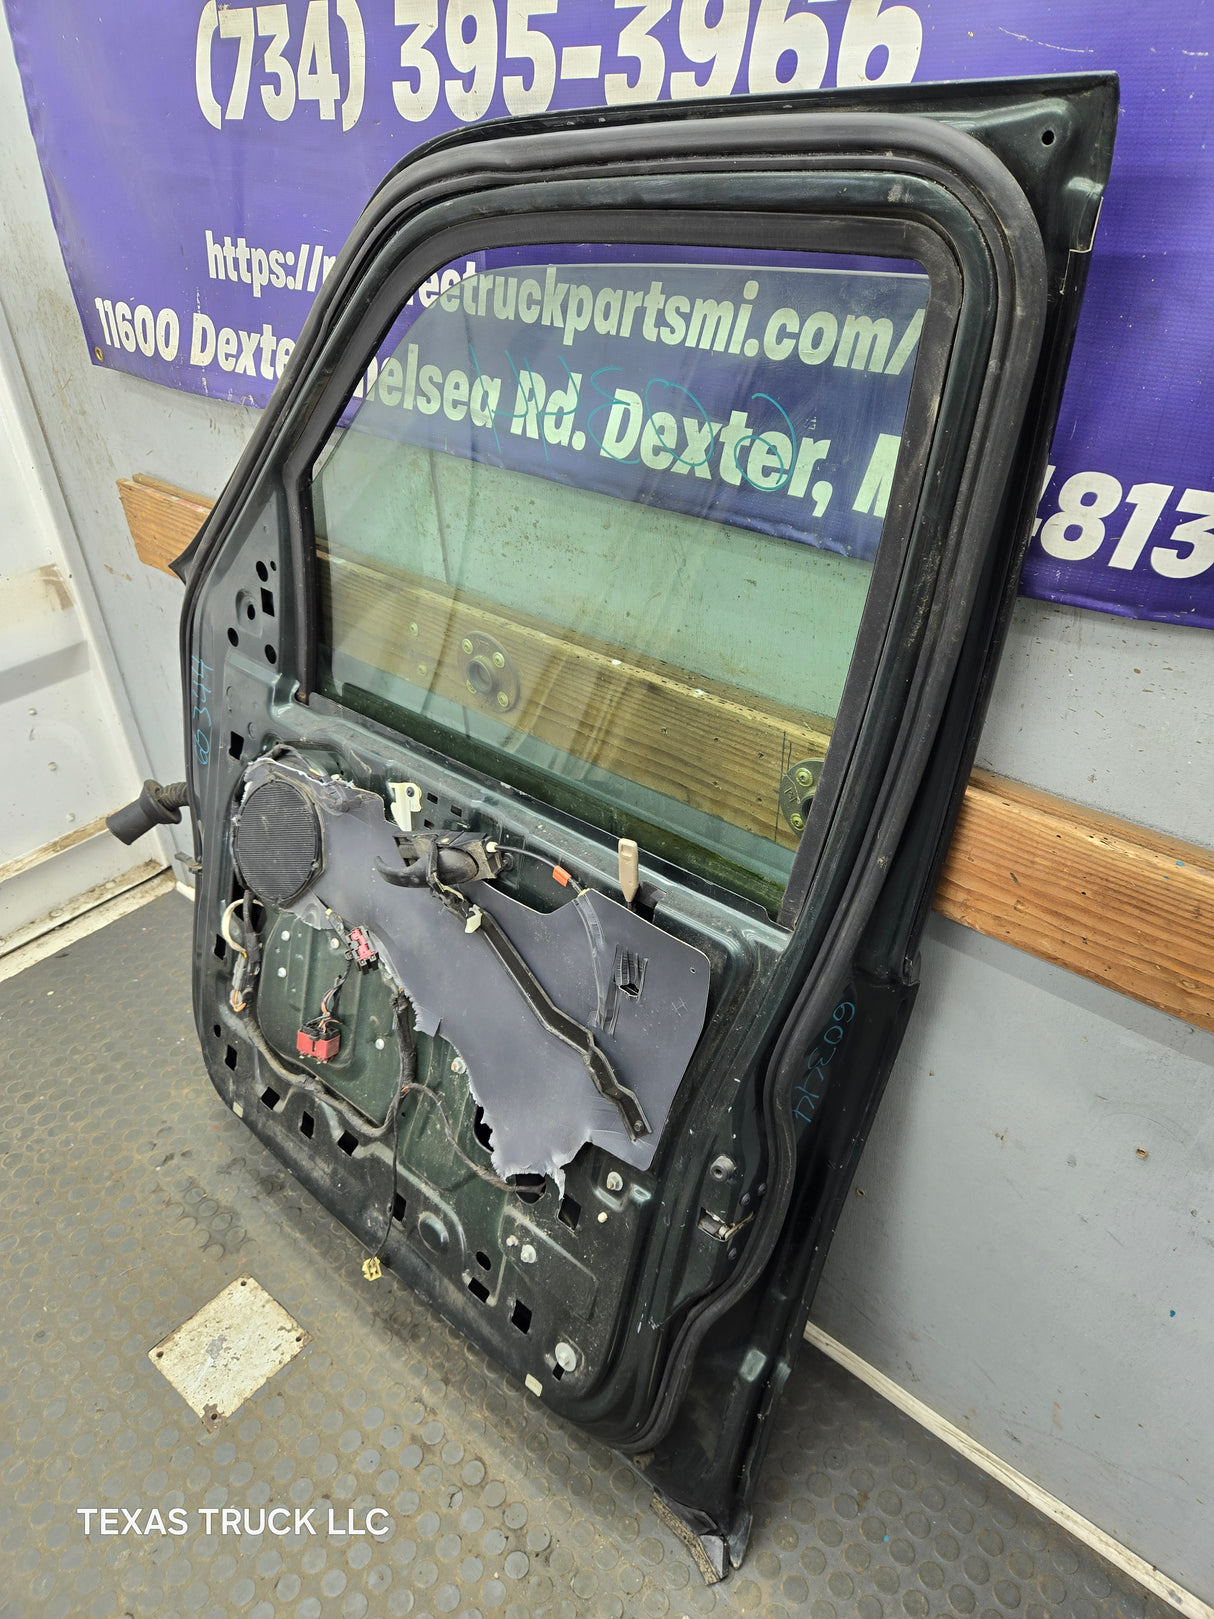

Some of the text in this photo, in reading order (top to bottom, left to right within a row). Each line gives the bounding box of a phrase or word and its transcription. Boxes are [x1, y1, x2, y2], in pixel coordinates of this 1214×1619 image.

[195, 0, 924, 131] (734) 395-3966
[94, 297, 180, 362] 11600
[190, 313, 296, 381] Dexte
[353, 343, 502, 427] helsea
[510, 370, 587, 451] Rd.
[600, 388, 832, 517] Dexter,
